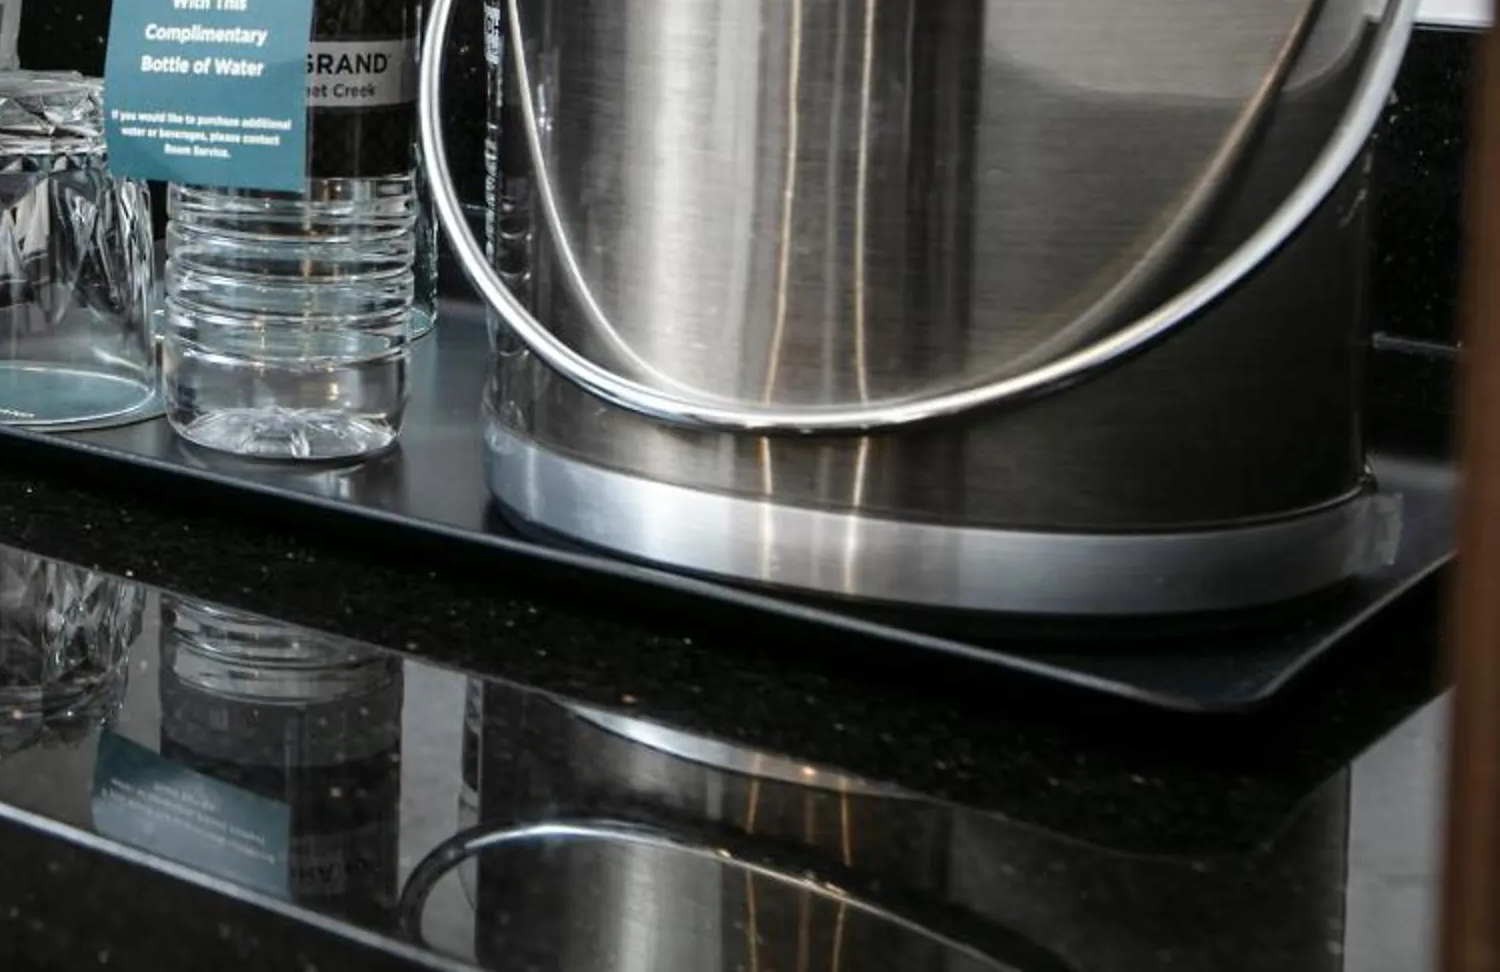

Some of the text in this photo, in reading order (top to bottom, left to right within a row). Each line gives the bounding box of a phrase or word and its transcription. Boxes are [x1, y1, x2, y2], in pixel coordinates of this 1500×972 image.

[145, 23, 268, 46] Complimentary
[140, 55, 265, 77] Bottle of Water
[333, 83, 375, 98] Creek
